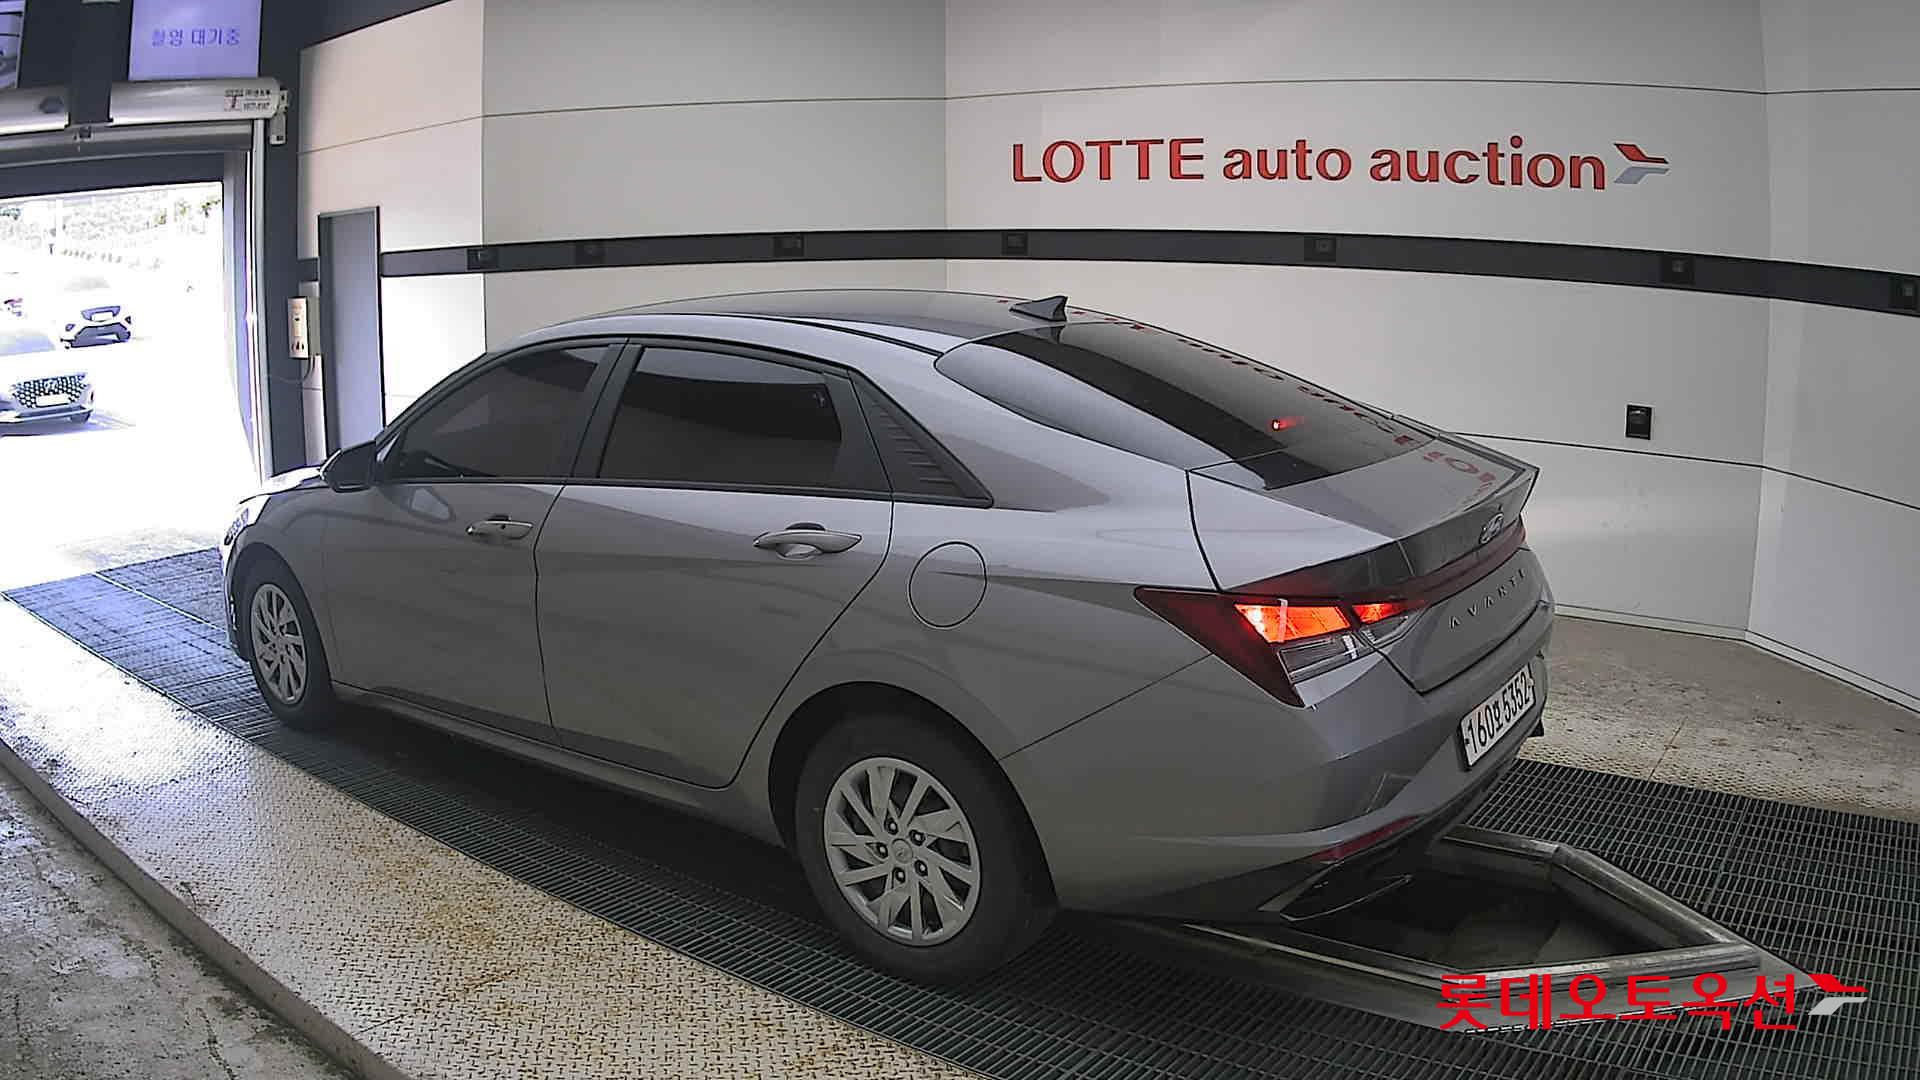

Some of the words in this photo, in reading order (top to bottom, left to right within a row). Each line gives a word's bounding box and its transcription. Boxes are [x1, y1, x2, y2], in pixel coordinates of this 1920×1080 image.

[191, 28, 240, 46] 대기중
[1012, 137, 1205, 184] LOTTE
[1222, 138, 1353, 183] auto
[1368, 135, 1608, 192] auction
[1501, 672, 1530, 723] 5352
